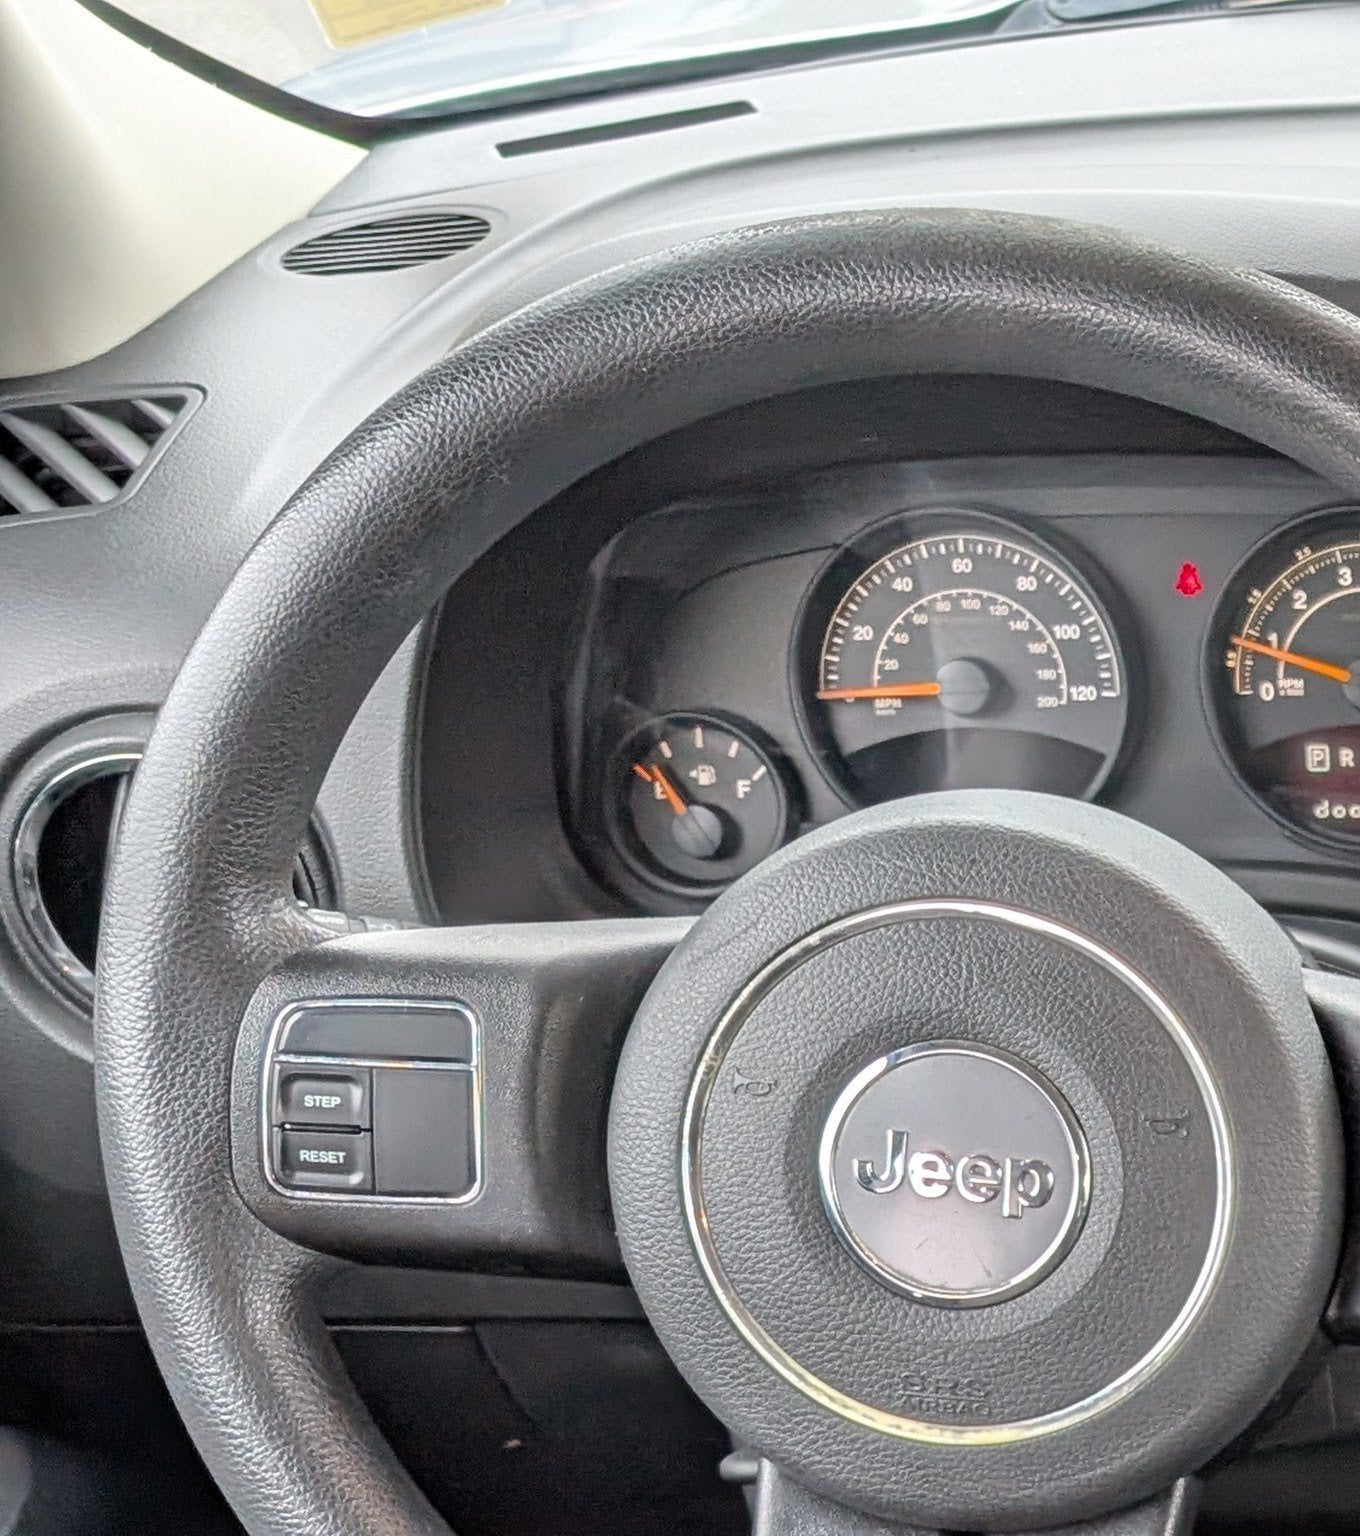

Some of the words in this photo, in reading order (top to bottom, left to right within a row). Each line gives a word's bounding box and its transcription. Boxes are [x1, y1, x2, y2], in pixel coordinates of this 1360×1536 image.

[952, 559, 973, 574] 60
[891, 576, 914, 593] 40
[1016, 575, 1038, 592] 80
[1338, 567, 1353, 587] 3
[1291, 589, 1308, 610] 2
[852, 624, 874, 642] 20
[1053, 624, 1081, 640] 100
[1069, 685, 1098, 702] 120
[1259, 681, 1275, 703] 0
[1338, 749, 1356, 768] R
[736, 779, 751, 798] F
[304, 1095, 341, 1109] STEP
[299, 1149, 347, 1164] RESET
[852, 1128, 1056, 1220] Jeep
